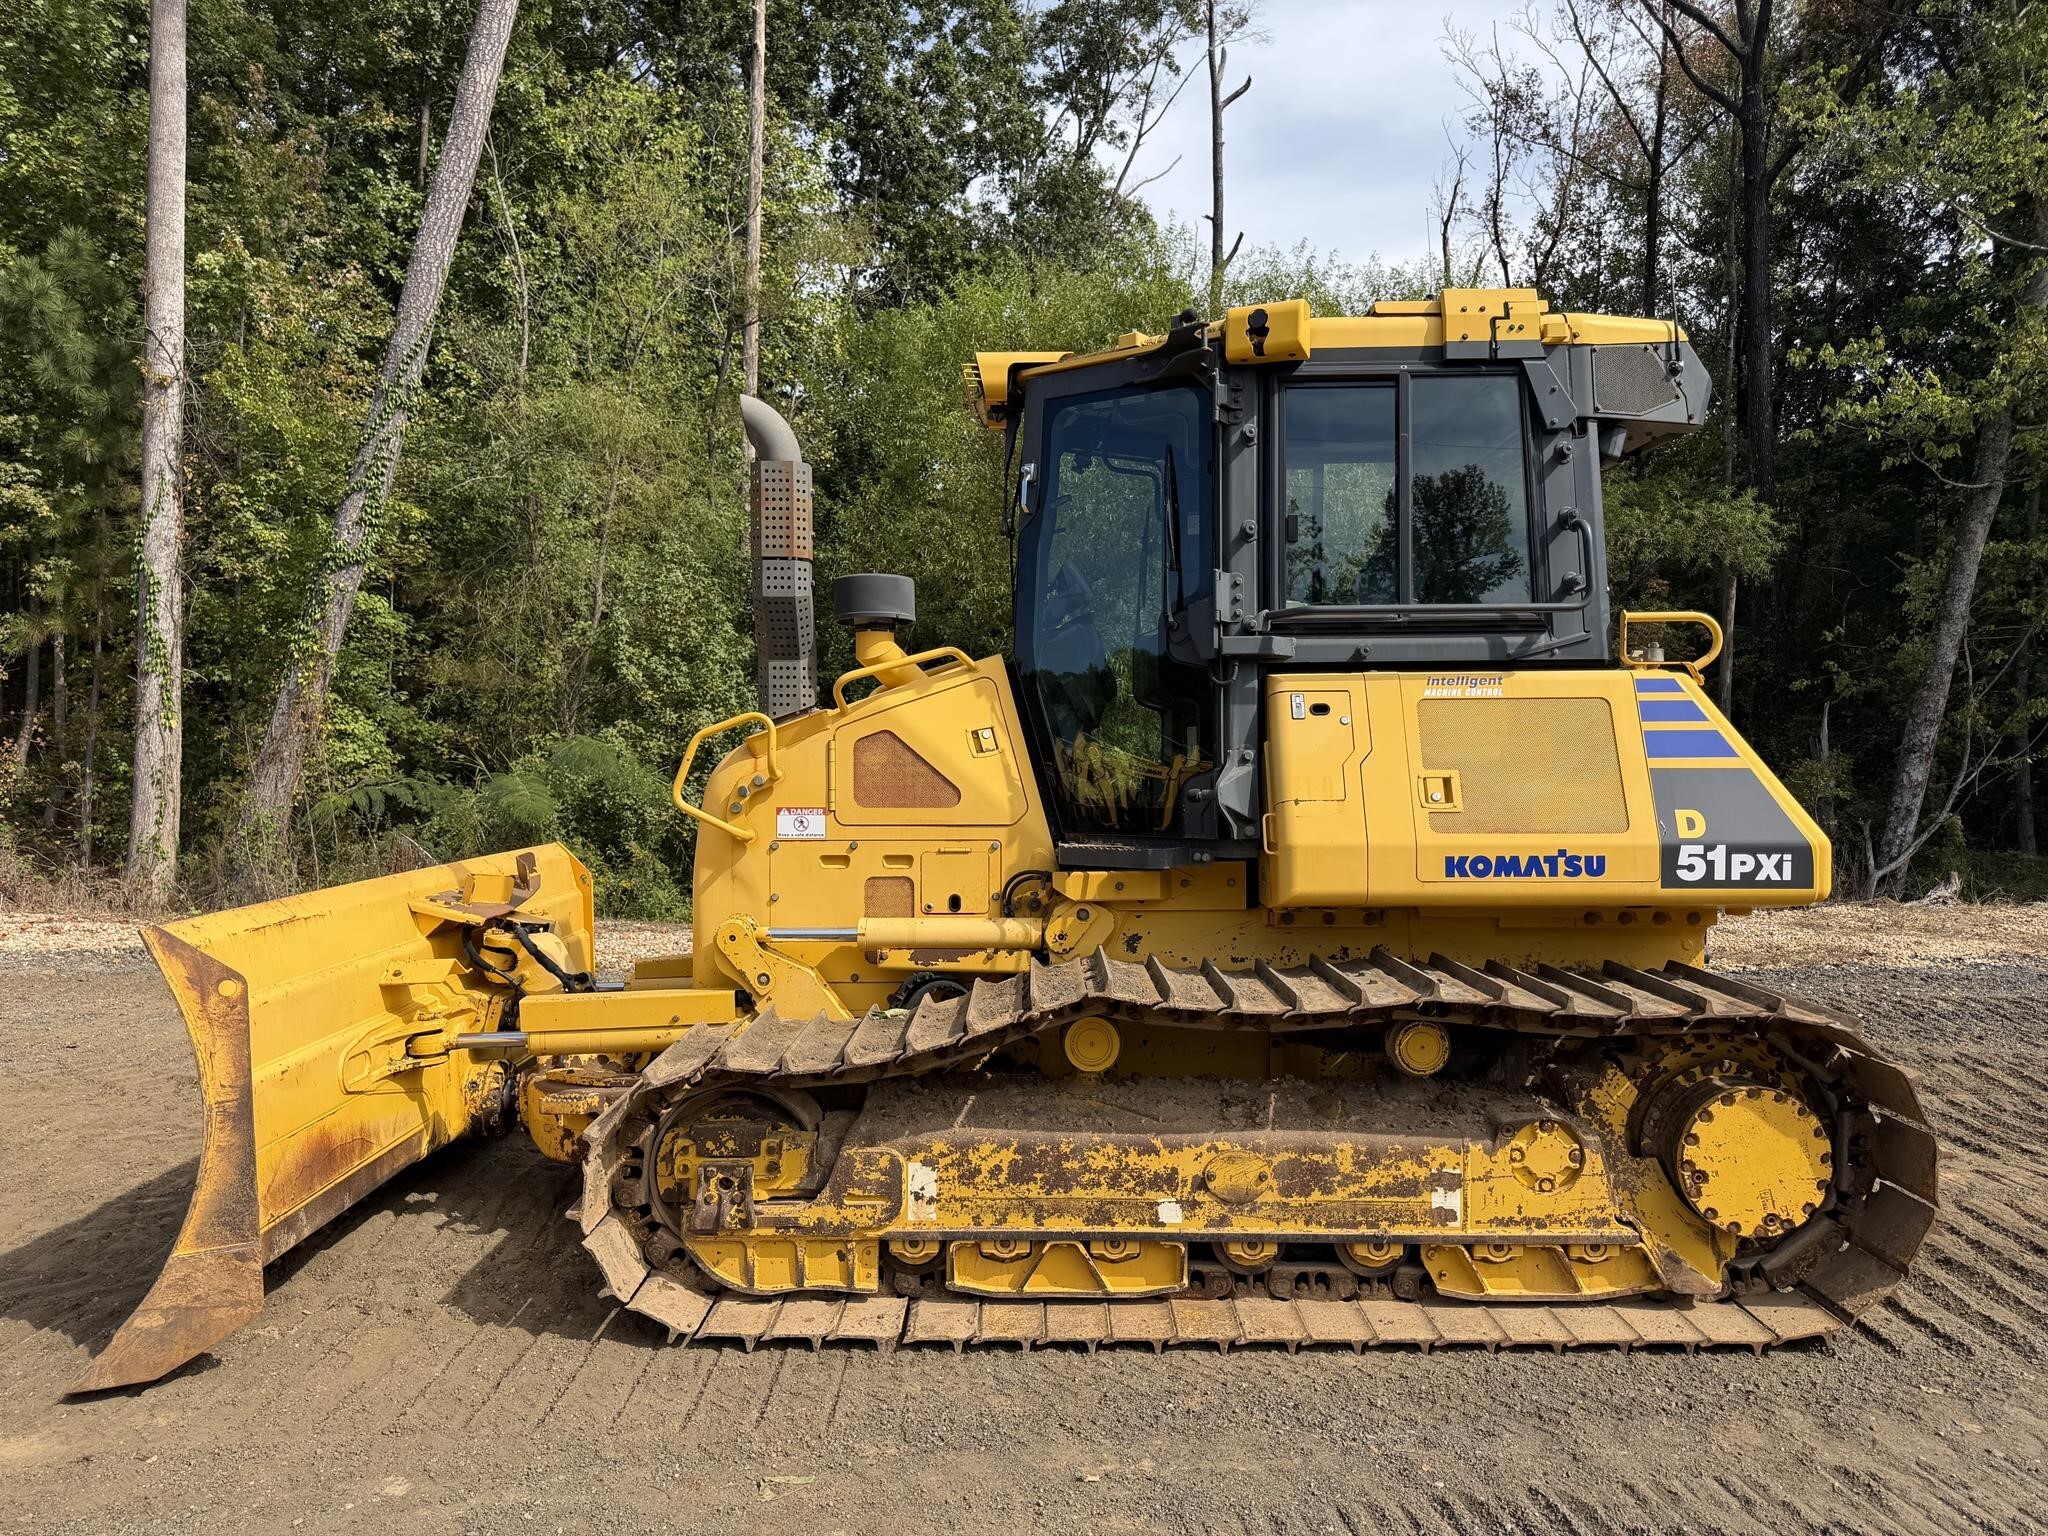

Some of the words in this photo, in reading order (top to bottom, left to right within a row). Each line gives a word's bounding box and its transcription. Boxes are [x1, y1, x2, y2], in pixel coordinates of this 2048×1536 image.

[1426, 676, 1503, 688] intelligent
[1424, 688, 1461, 697] MACHINE
[1465, 688, 1503, 697] CONTROL
[1674, 809, 1706, 839] D
[1444, 849, 1606, 878] KOMATSU
